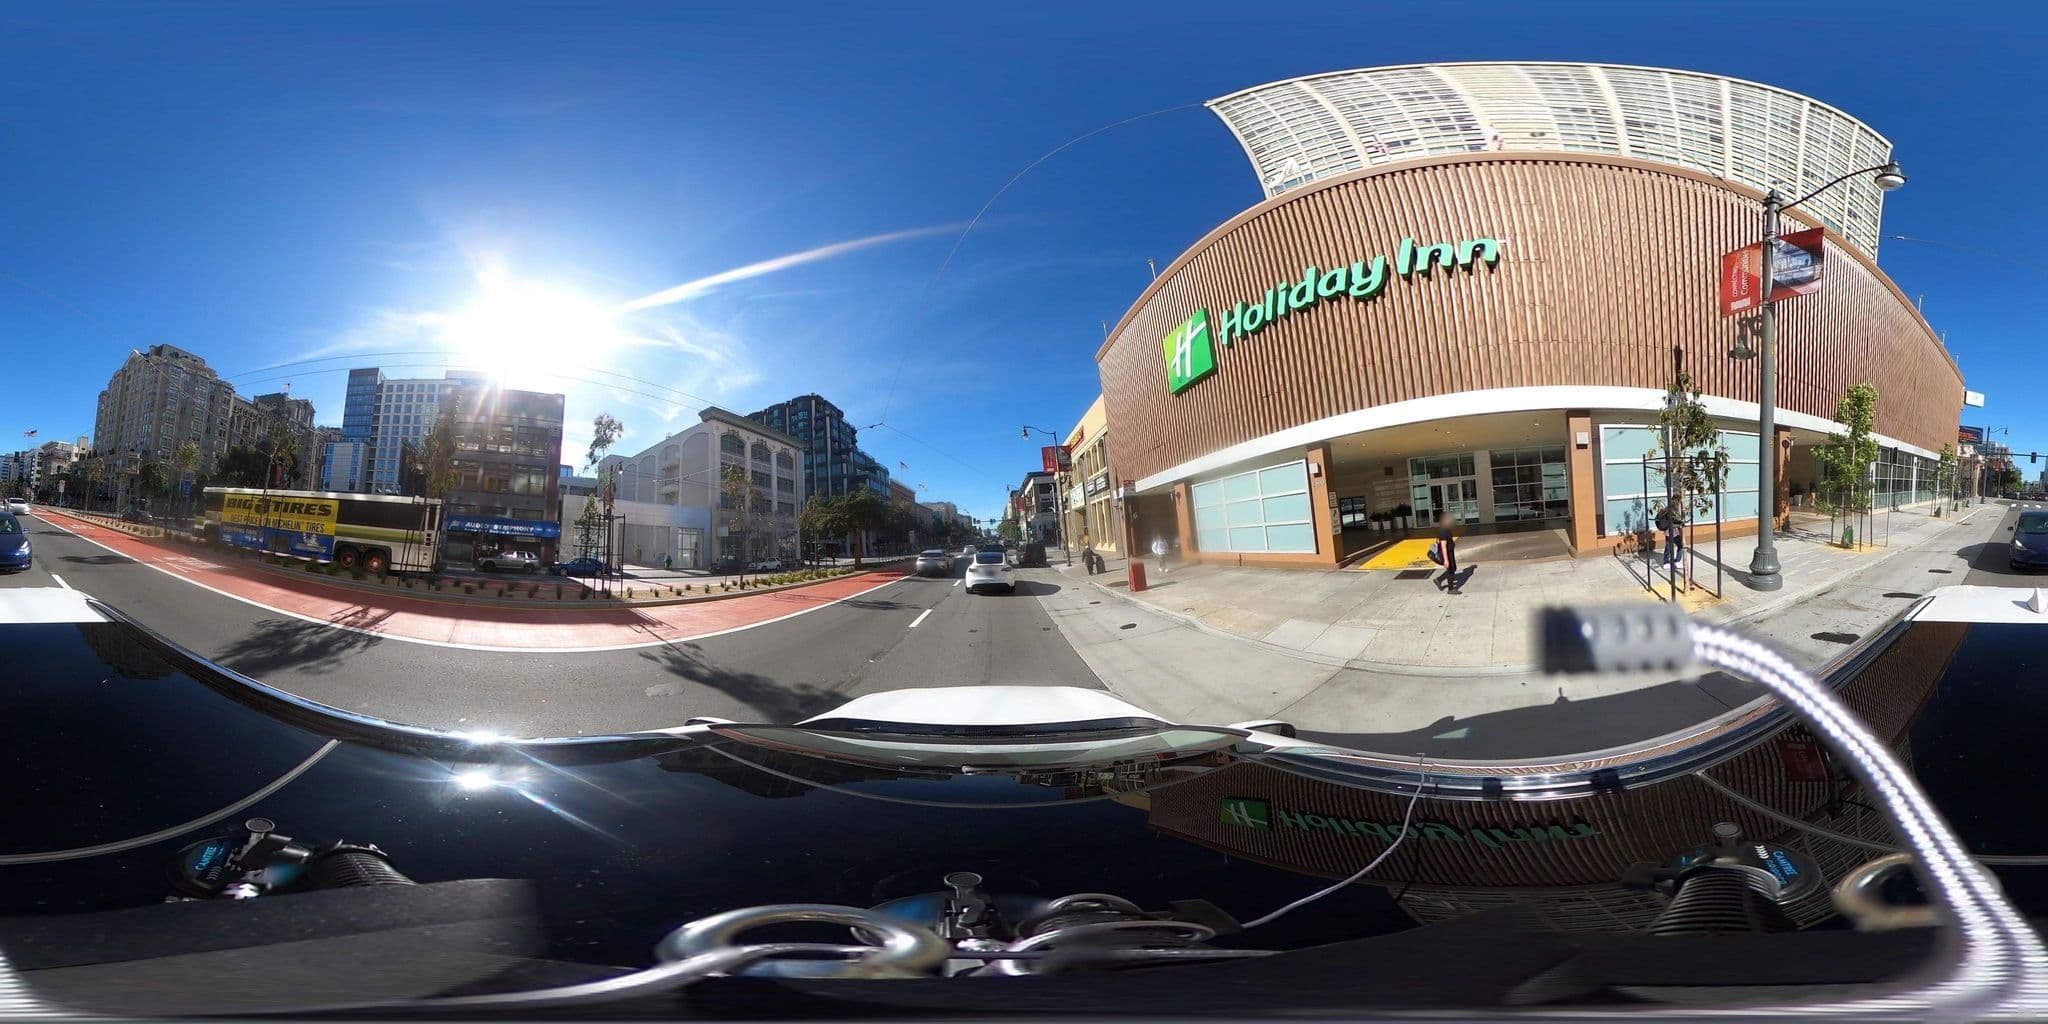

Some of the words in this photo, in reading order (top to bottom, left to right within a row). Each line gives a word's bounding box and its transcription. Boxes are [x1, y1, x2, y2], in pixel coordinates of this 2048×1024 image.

[1219, 254, 1387, 347] Holiday
[1397, 236, 1500, 276] Inn
[1172, 312, 1206, 378] H
[225, 498, 253, 510] BIG
[270, 500, 332, 516] TIRES
[305, 521, 325, 533] TIRES
[464, 521, 489, 529] AUDIO
